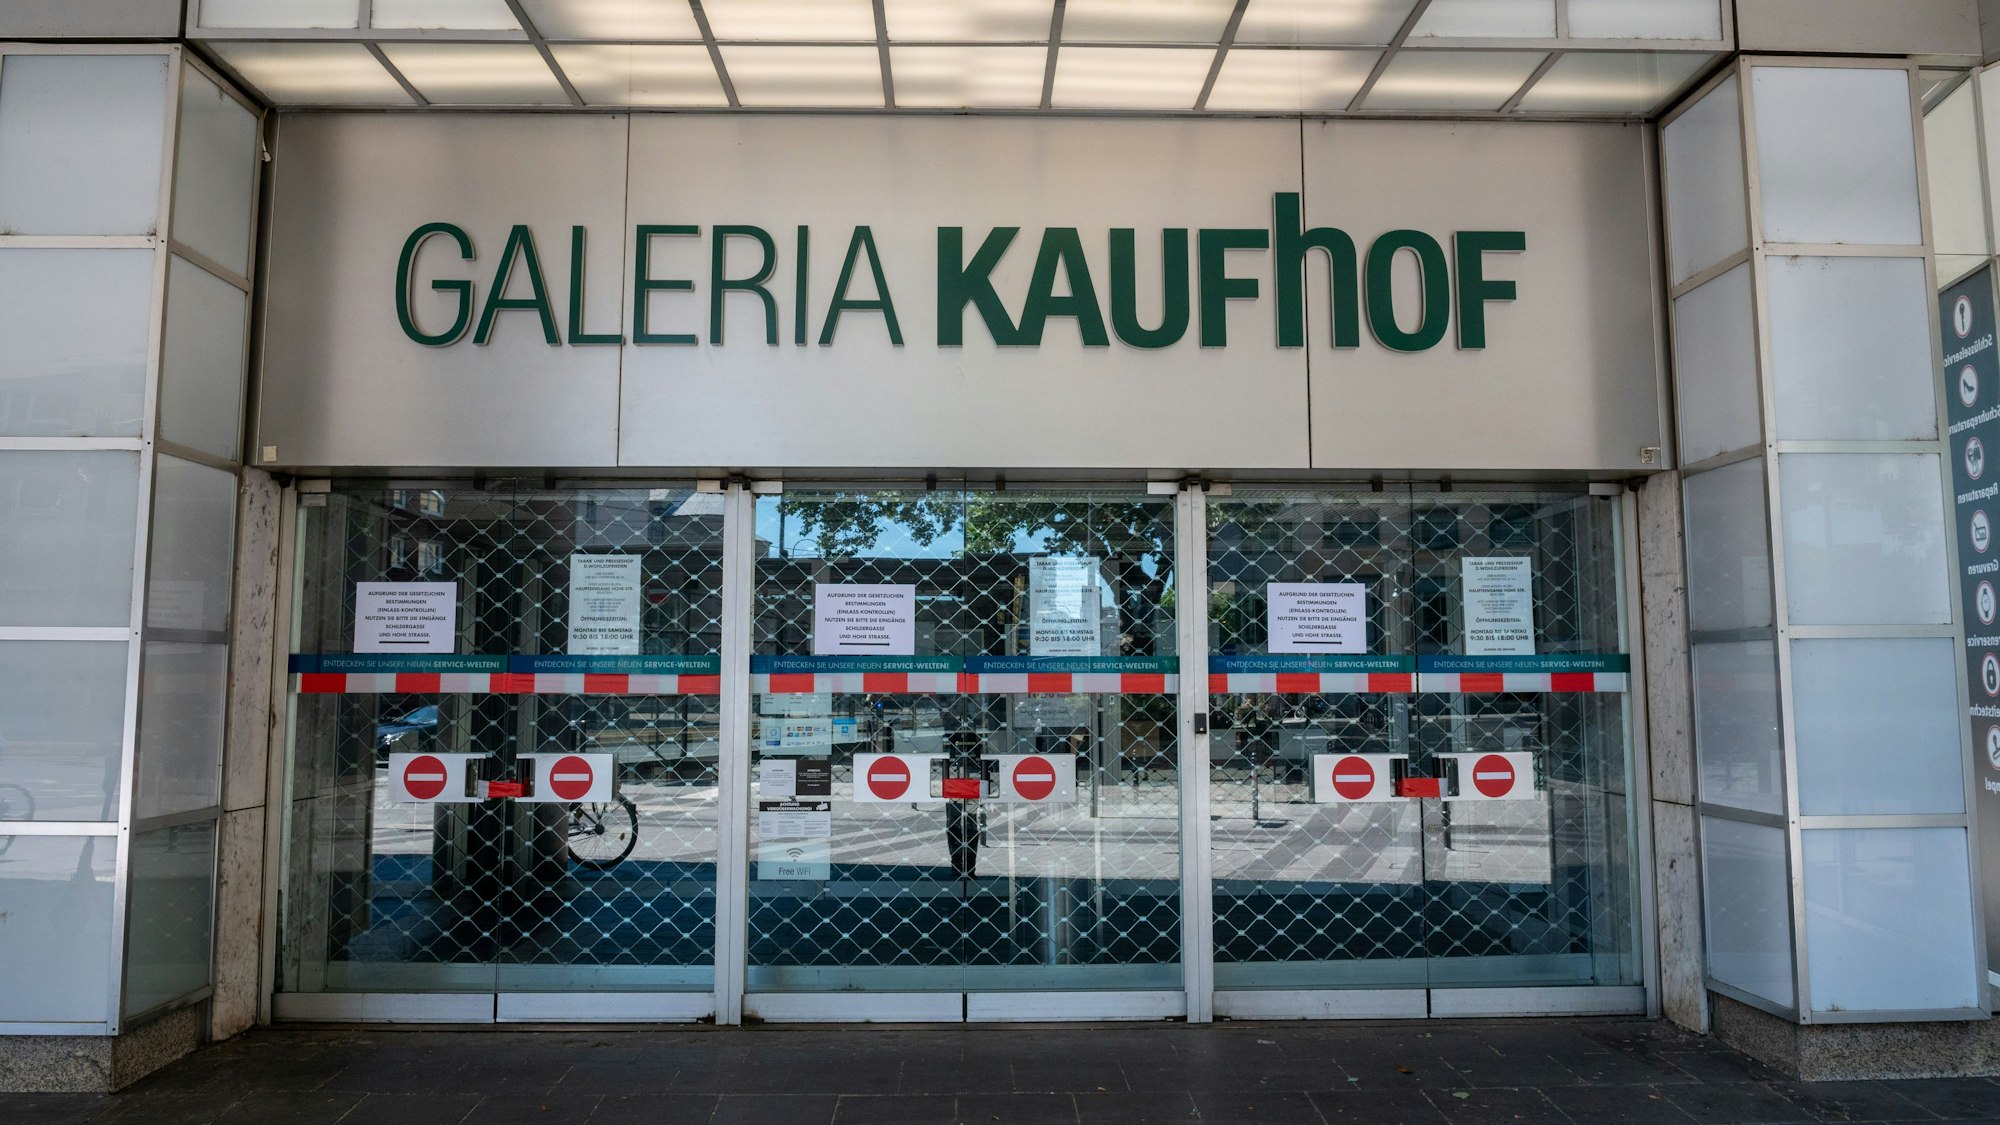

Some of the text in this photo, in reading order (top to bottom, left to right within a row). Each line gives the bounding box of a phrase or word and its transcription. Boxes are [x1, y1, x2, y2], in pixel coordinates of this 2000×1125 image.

[394, 221, 905, 348] GALERIA
[407, 660, 431, 668] NEUEN
[433, 660, 499, 668] SERVICE-WELTEN!
[534, 660, 575, 668] ENTDECKEN
[577, 660, 587, 668] SIE
[589, 660, 616, 668] UNSERE
[857, 661, 881, 669] NEUEN
[984, 661, 1025, 669] ENTDECKEN
[1026, 661, 1037, 669] SIE
[1038, 661, 1065, 669] UNSERE
[1309, 661, 1333, 669] NEUEN
[1540, 660, 1604, 668] SERVICE-WELTEN!
[779, 867, 810, 875] Free WiFi
